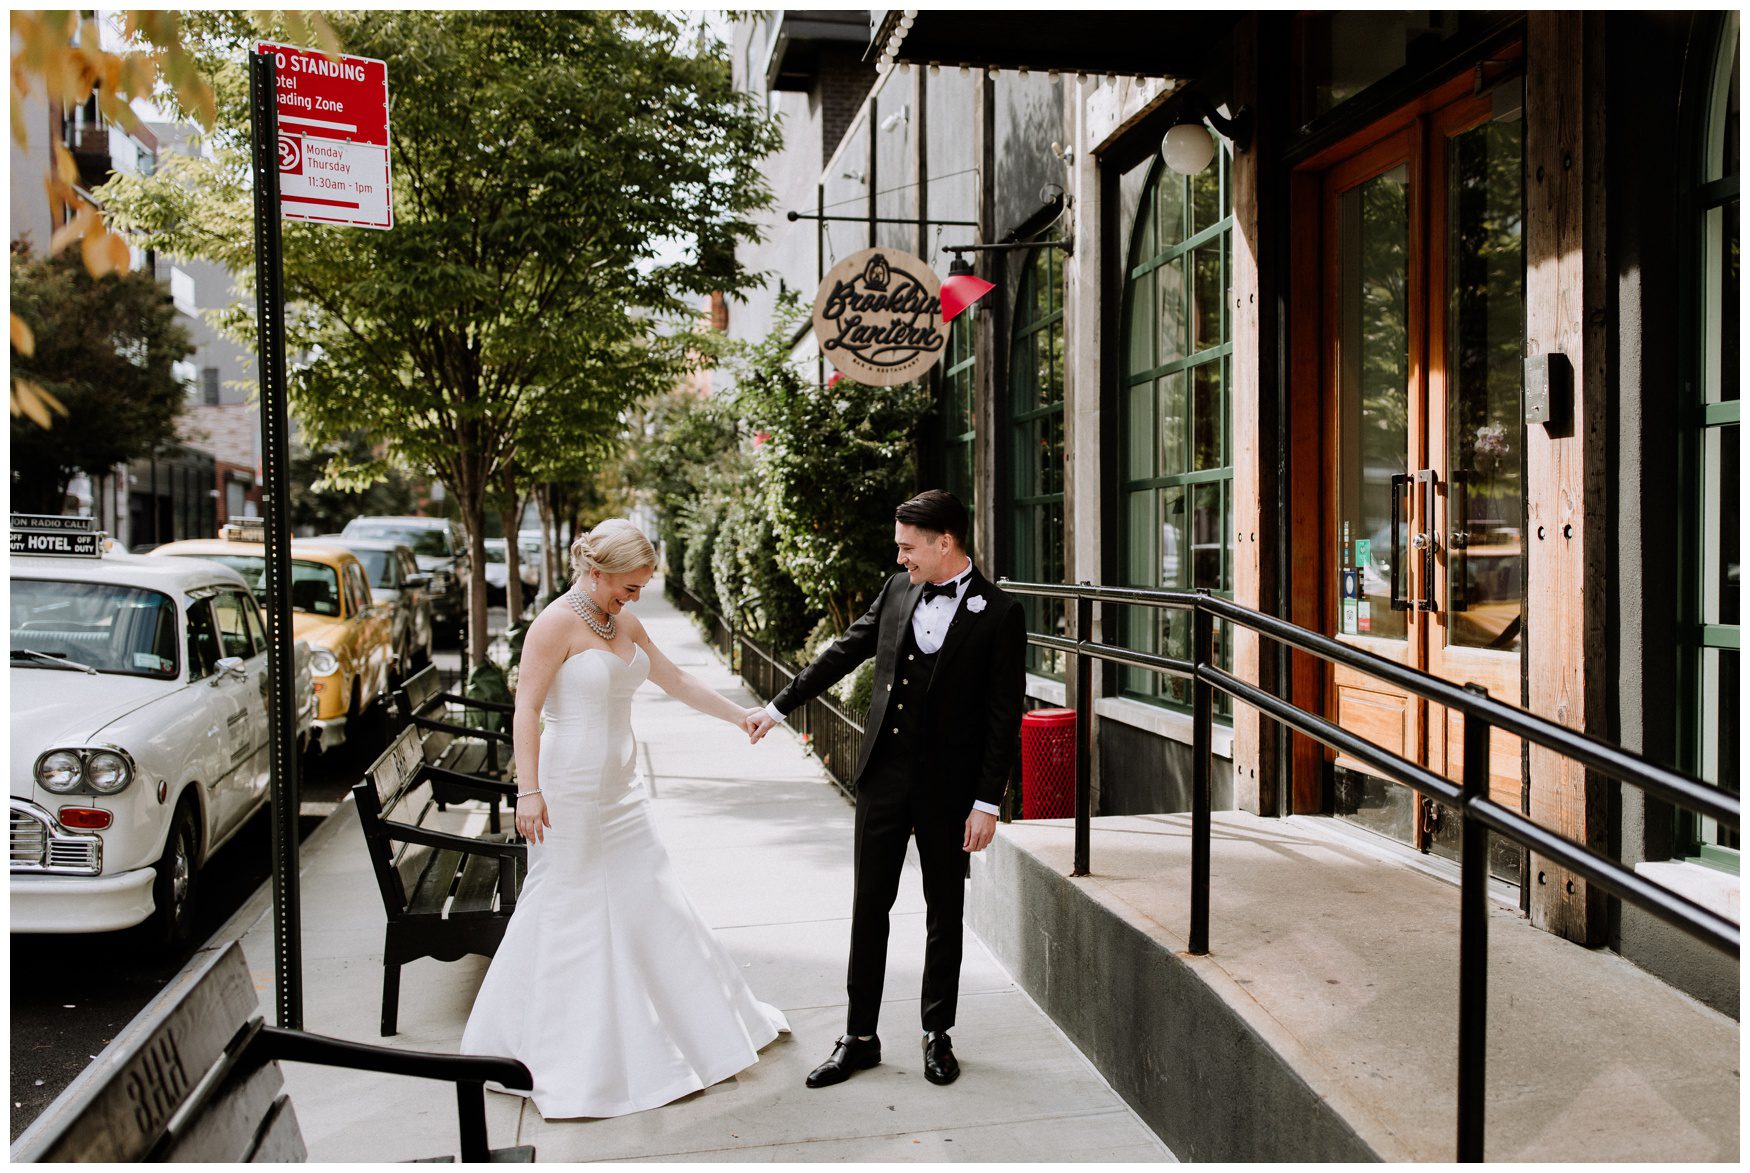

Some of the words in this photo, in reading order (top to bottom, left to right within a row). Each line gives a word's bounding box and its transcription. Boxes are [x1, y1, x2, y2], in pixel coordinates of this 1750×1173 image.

[290, 54, 365, 82] STANDING
[276, 74, 297, 90] otel
[276, 92, 312, 111] ading
[315, 96, 344, 112] Zone
[306, 144, 343, 160] Monday
[308, 157, 351, 174] Thursday
[308, 176, 346, 190] 11:30am
[355, 182, 373, 194] 1pm
[822, 279, 942, 327] Brooklyn
[823, 315, 944, 359] Lantern
[13, 517, 28, 526] ON
[30, 519, 61, 528] RADIO
[64, 520, 88, 529] CALL
[10, 543, 25, 551] UTY
[28, 535, 72, 551] HOTEL
[74, 544, 94, 552] DUTY
[77, 536, 92, 544] OFF
